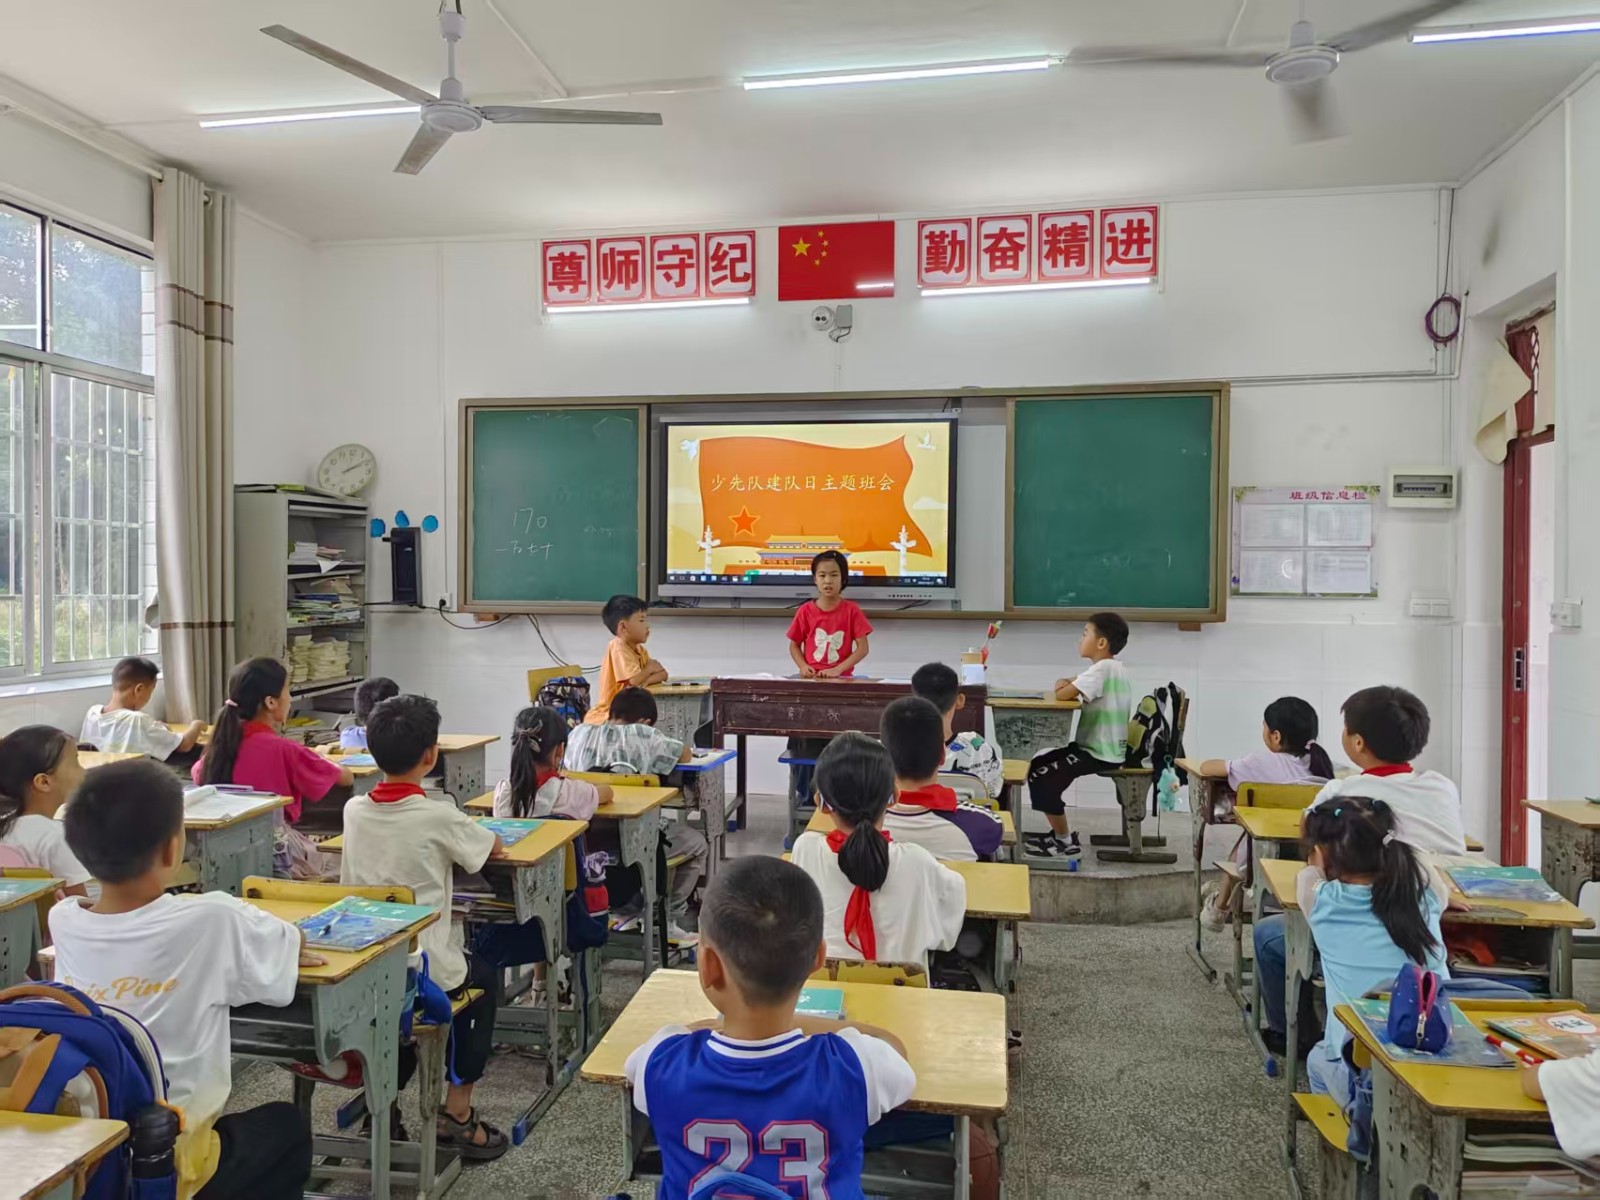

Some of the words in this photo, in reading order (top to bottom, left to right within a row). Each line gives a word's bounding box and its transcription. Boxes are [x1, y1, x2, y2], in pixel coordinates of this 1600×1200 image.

[548, 241, 751, 294] 尊师守纪
[924, 218, 1152, 276] 勤奋精进
[711, 472, 895, 492] 少先队建队日主题班会
[1289, 490, 1367, 501] 班级信息栏
[512, 506, 548, 535] 170
[683, 1118, 830, 1200] 23
